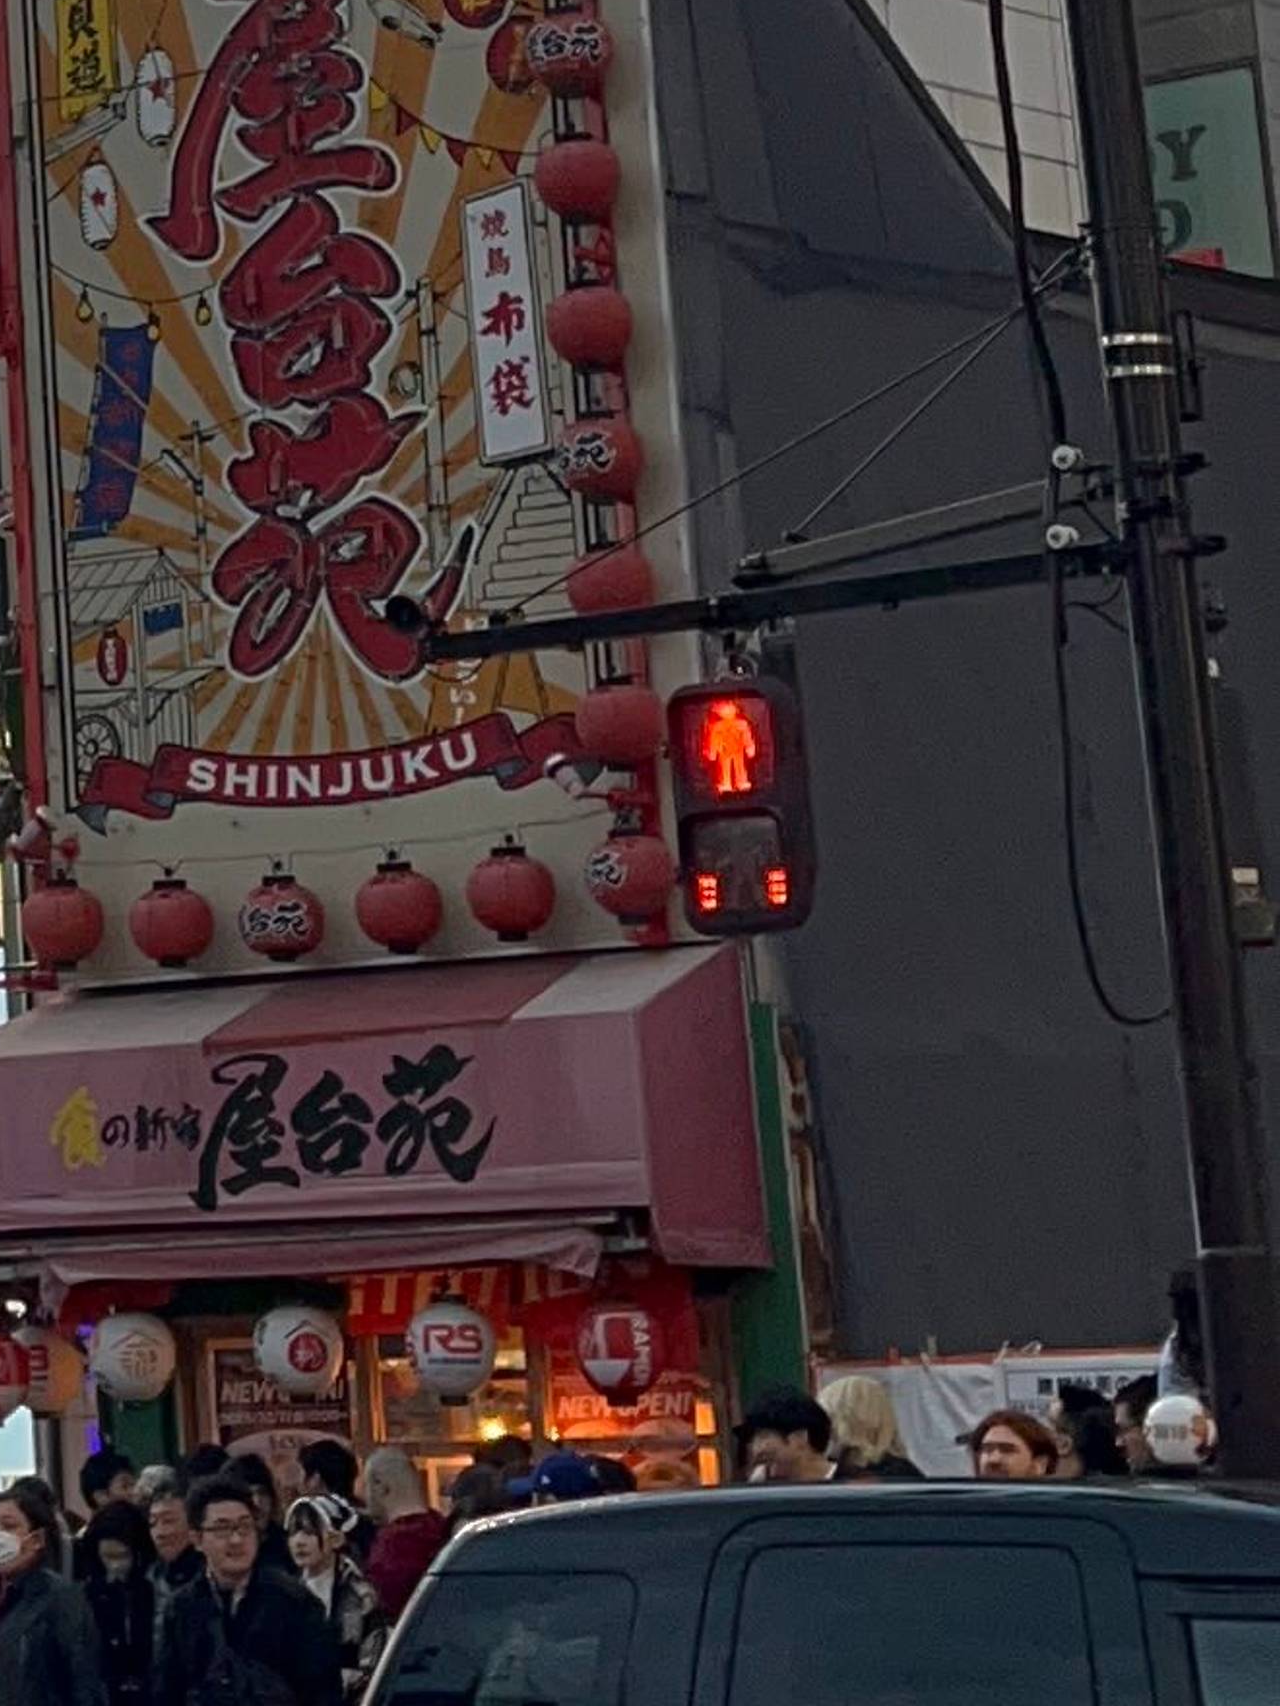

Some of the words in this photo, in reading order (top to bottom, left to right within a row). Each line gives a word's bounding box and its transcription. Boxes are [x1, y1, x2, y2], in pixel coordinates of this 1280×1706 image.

[479, 290, 536, 417] 布袋
[185, 734, 478, 800] SHINJUKU
[189, 1044, 496, 1212] 屋台苑
[422, 1324, 483, 1355] RS
[614, 1390, 693, 1419] PEN!
